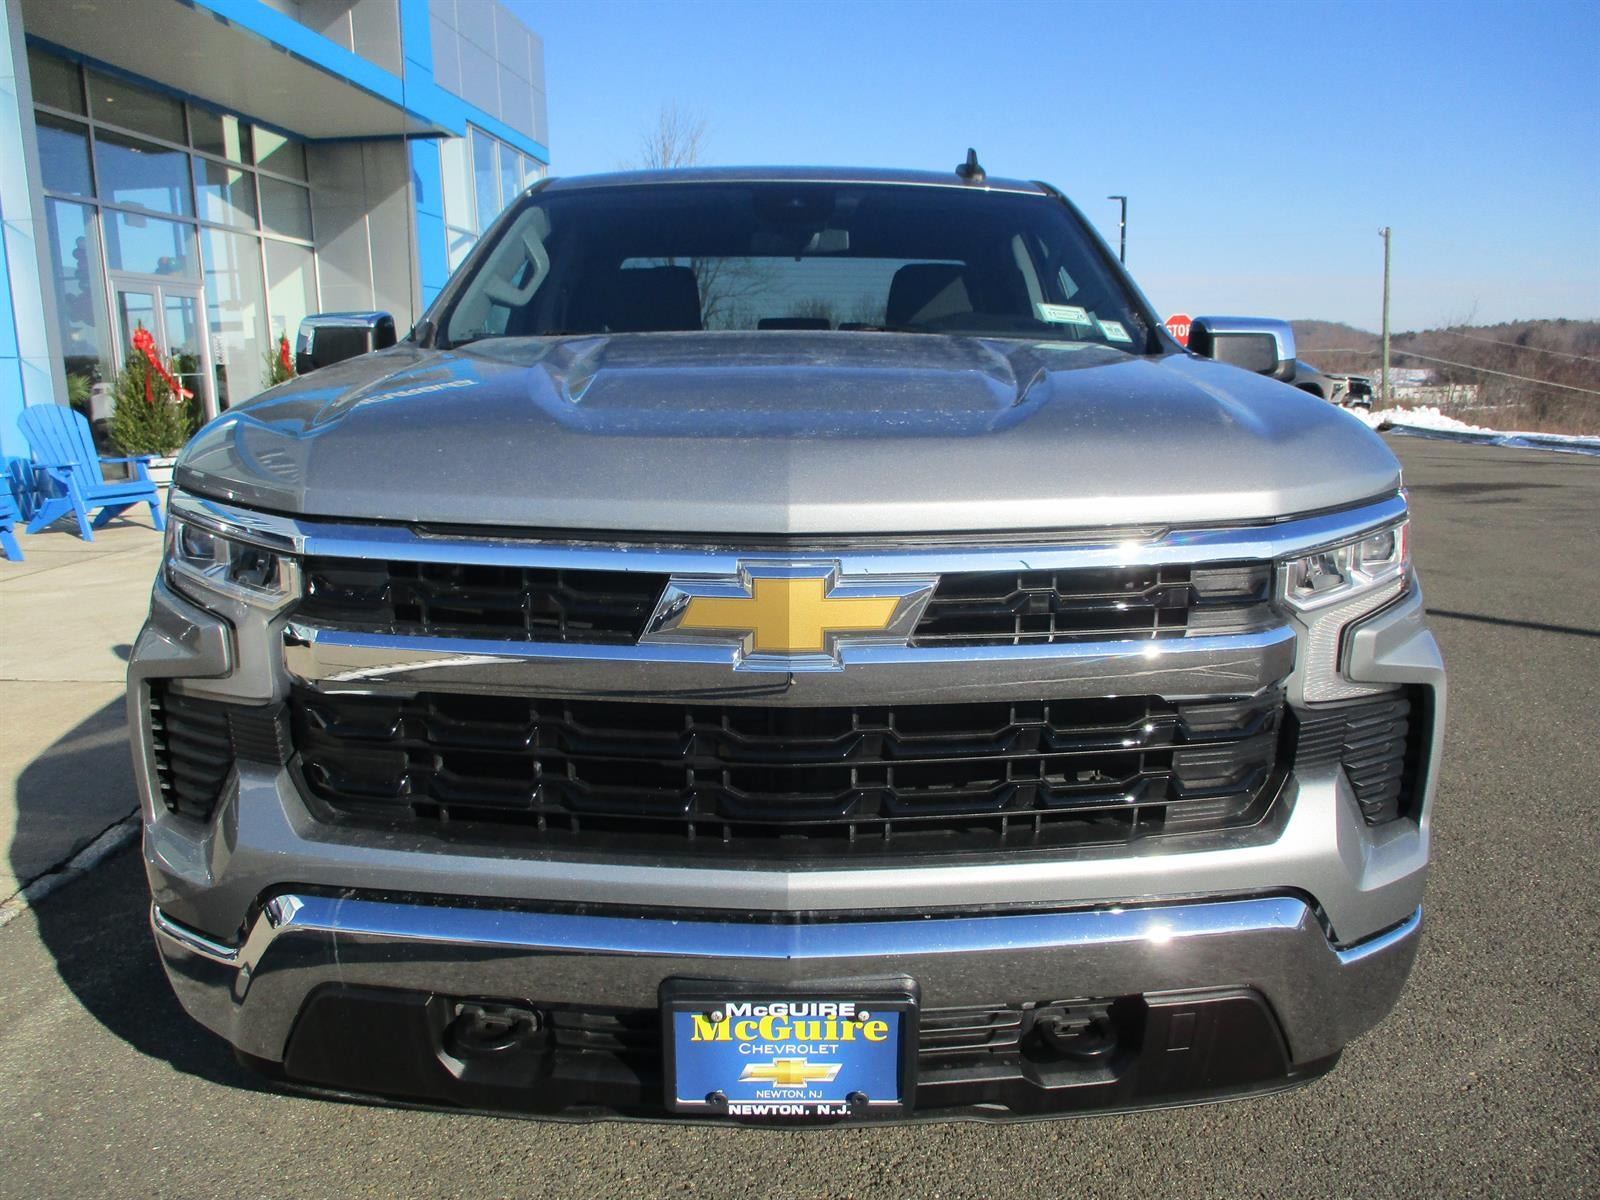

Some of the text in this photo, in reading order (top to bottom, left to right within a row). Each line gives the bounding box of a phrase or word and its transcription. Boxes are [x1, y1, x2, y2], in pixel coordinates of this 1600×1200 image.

[725, 1003, 856, 1017] McGUIRE
[690, 1014, 889, 1042] McGuire
[738, 1043, 839, 1055] CHEVROLET
[756, 1089, 824, 1099] NEWTON, NJ
[817, 1104, 852, 1115] N.J.
